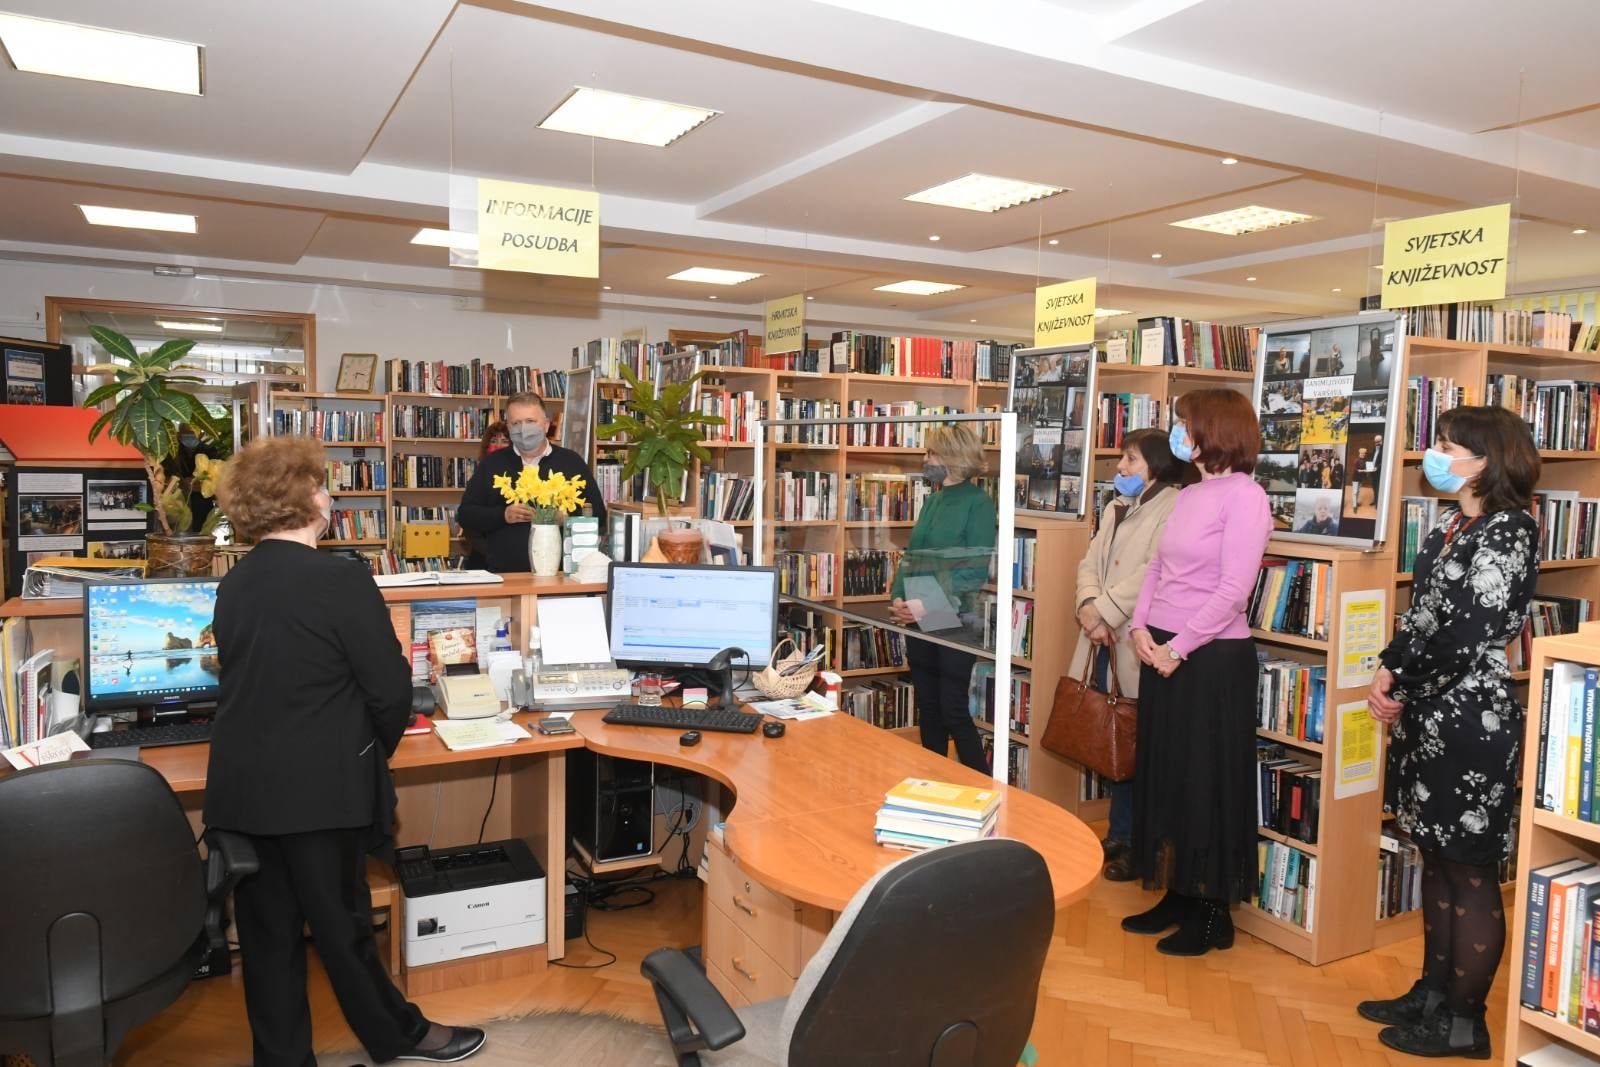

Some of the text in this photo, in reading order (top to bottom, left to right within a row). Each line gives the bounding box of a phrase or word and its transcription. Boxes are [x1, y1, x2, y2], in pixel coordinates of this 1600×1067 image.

[486, 199, 594, 226] INFORMACIJE
[501, 232, 579, 253] POSUDBA
[1404, 227, 1484, 254] SVJETSKA
[1387, 257, 1505, 287] KNJIŽEVNOST
[1045, 292, 1084, 310] SVJETSKA
[771, 305, 798, 320] HRVATSKA
[767, 325, 801, 341] KNJIŽEVNOST
[1037, 313, 1094, 333] KNJIŽEVNOST
[1584, 688, 1595, 763] FILOZOFIJA HODANJA
[467, 901, 490, 909] Canon
